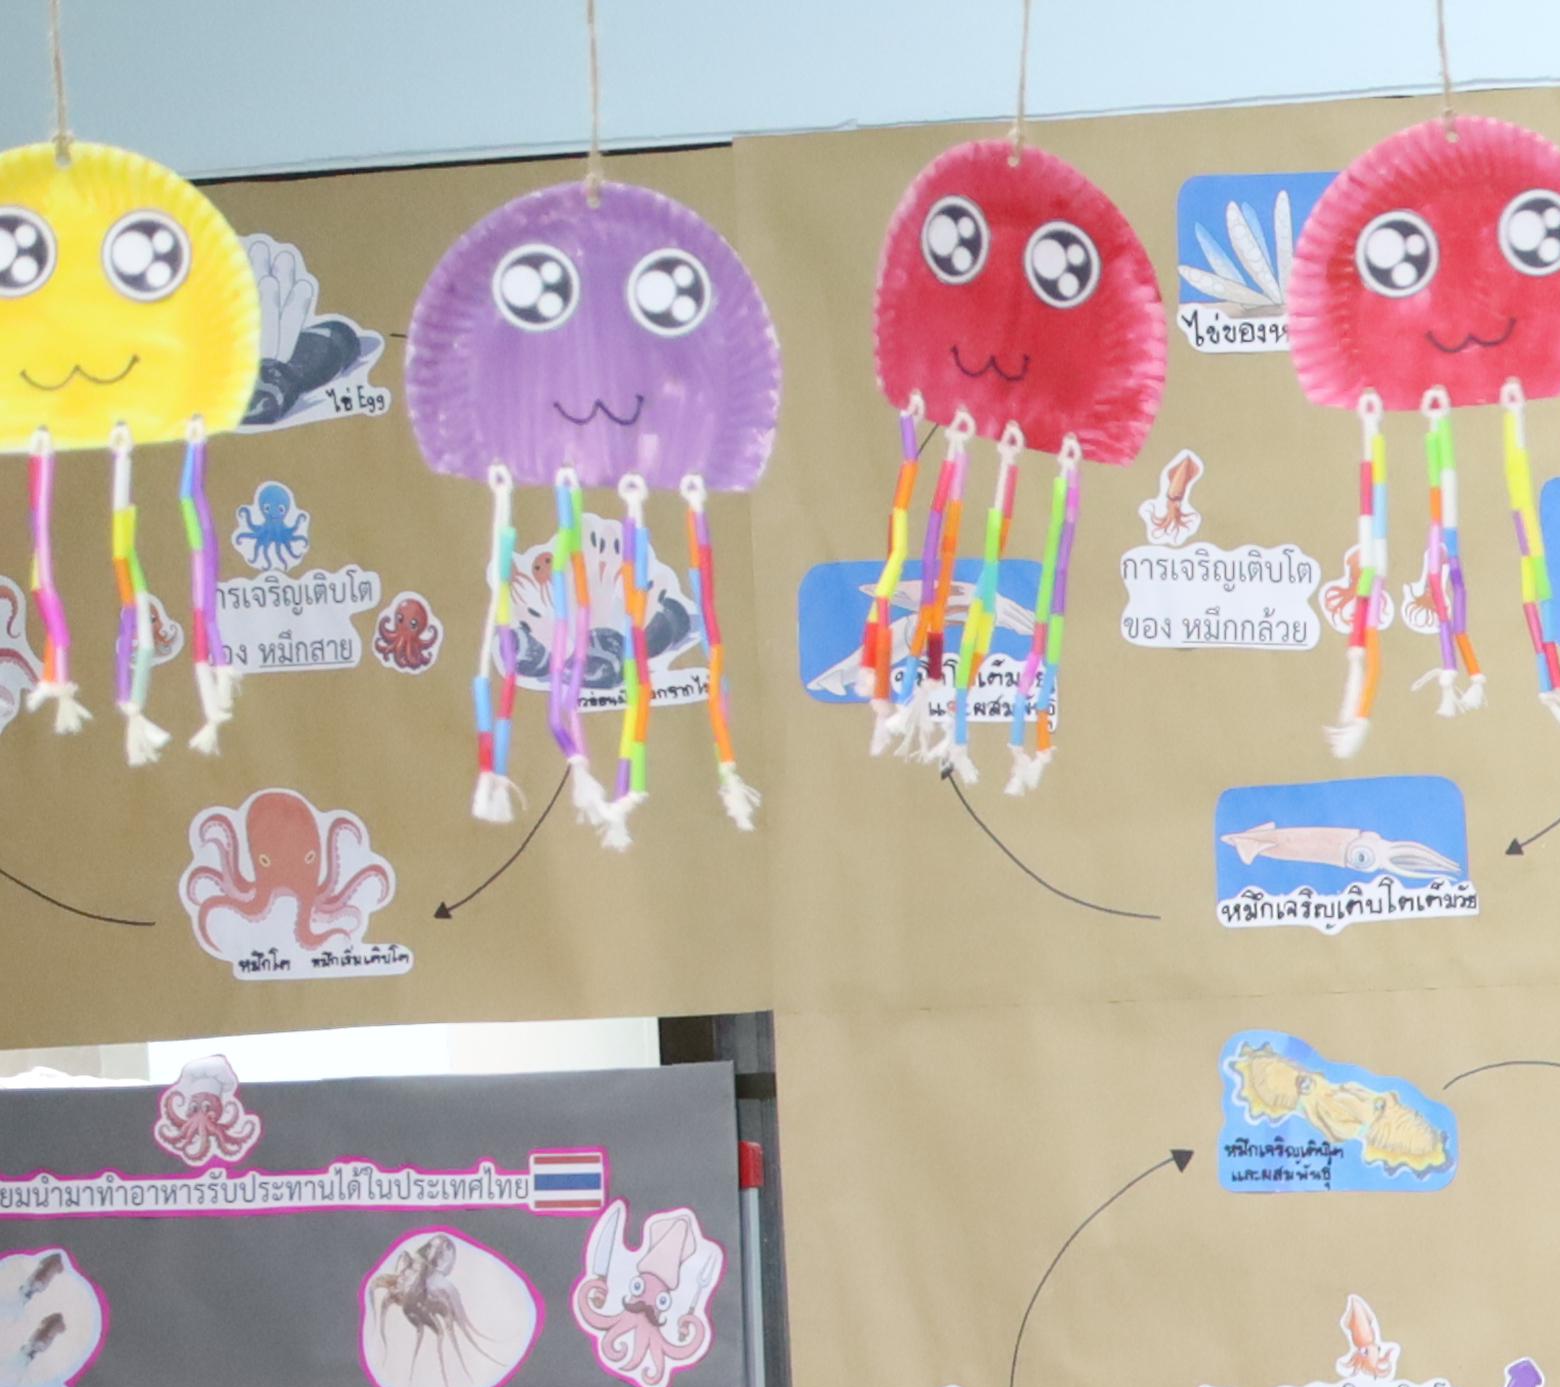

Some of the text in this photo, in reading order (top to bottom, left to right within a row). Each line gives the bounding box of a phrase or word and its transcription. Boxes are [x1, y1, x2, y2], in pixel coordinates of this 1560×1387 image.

[358, 386, 385, 413] Egg
[1121, 549, 1313, 592] การเจริญเติบโต
[216, 569, 373, 616] ารเจริญเติบโต
[1123, 607, 1309, 643] ของ หมึกกล้วย
[258, 630, 354, 664] หมึกสาย
